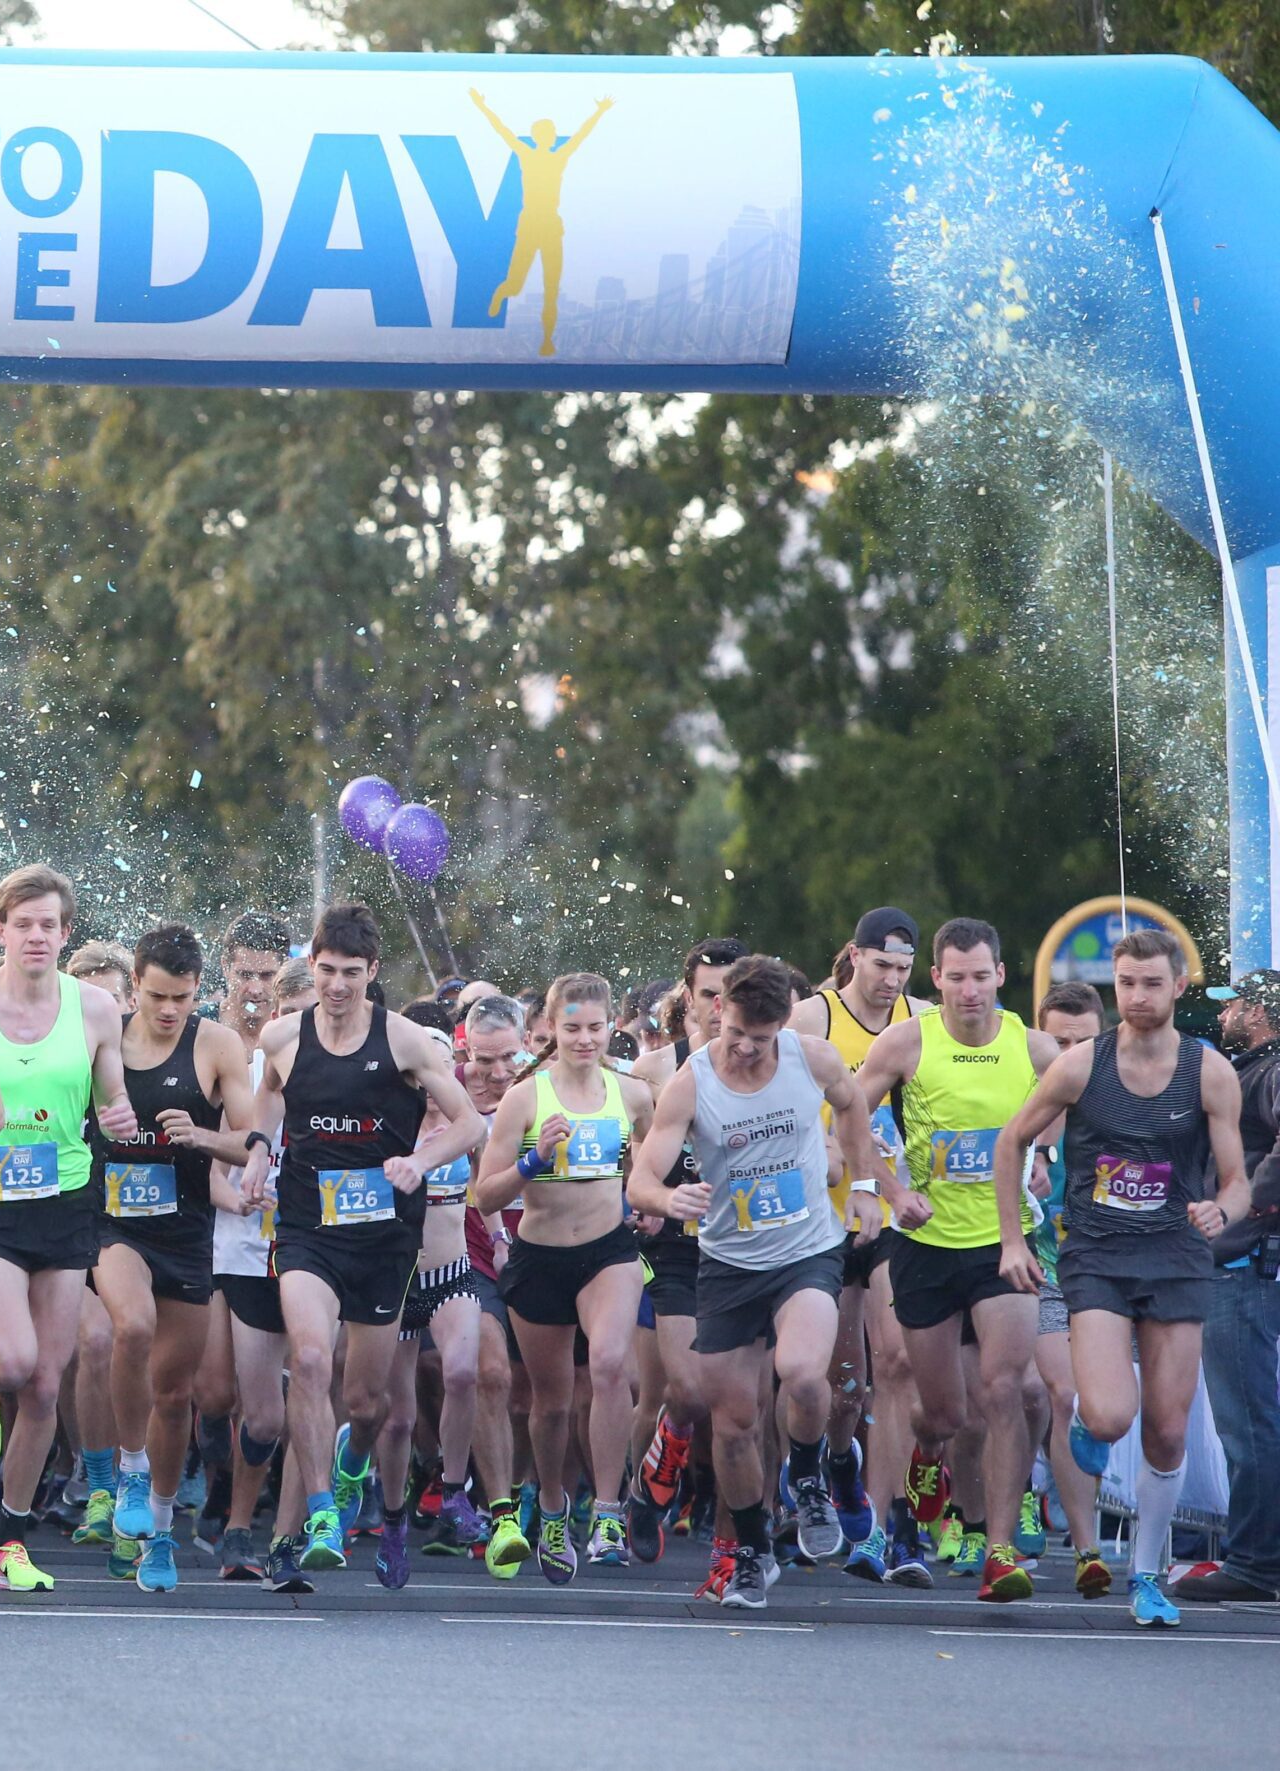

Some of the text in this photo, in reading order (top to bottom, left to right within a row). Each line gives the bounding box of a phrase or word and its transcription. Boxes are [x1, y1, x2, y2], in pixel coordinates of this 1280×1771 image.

[95, 129, 572, 328] DAY
[952, 1054, 1000, 1065] saucony
[722, 1119, 754, 1131] SEASON
[749, 1120, 794, 1140] injinji
[578, 1143, 602, 1161] 13
[950, 1151, 989, 1169] 134
[5, 1167, 43, 1185] 125
[729, 1166, 766, 1178] SOUTH
[769, 1160, 795, 1173] EAST
[123, 1185, 160, 1203] 129
[339, 1190, 378, 1210] 126
[758, 1197, 786, 1216] 31
[541, 1553, 572, 1573] BROOKS
